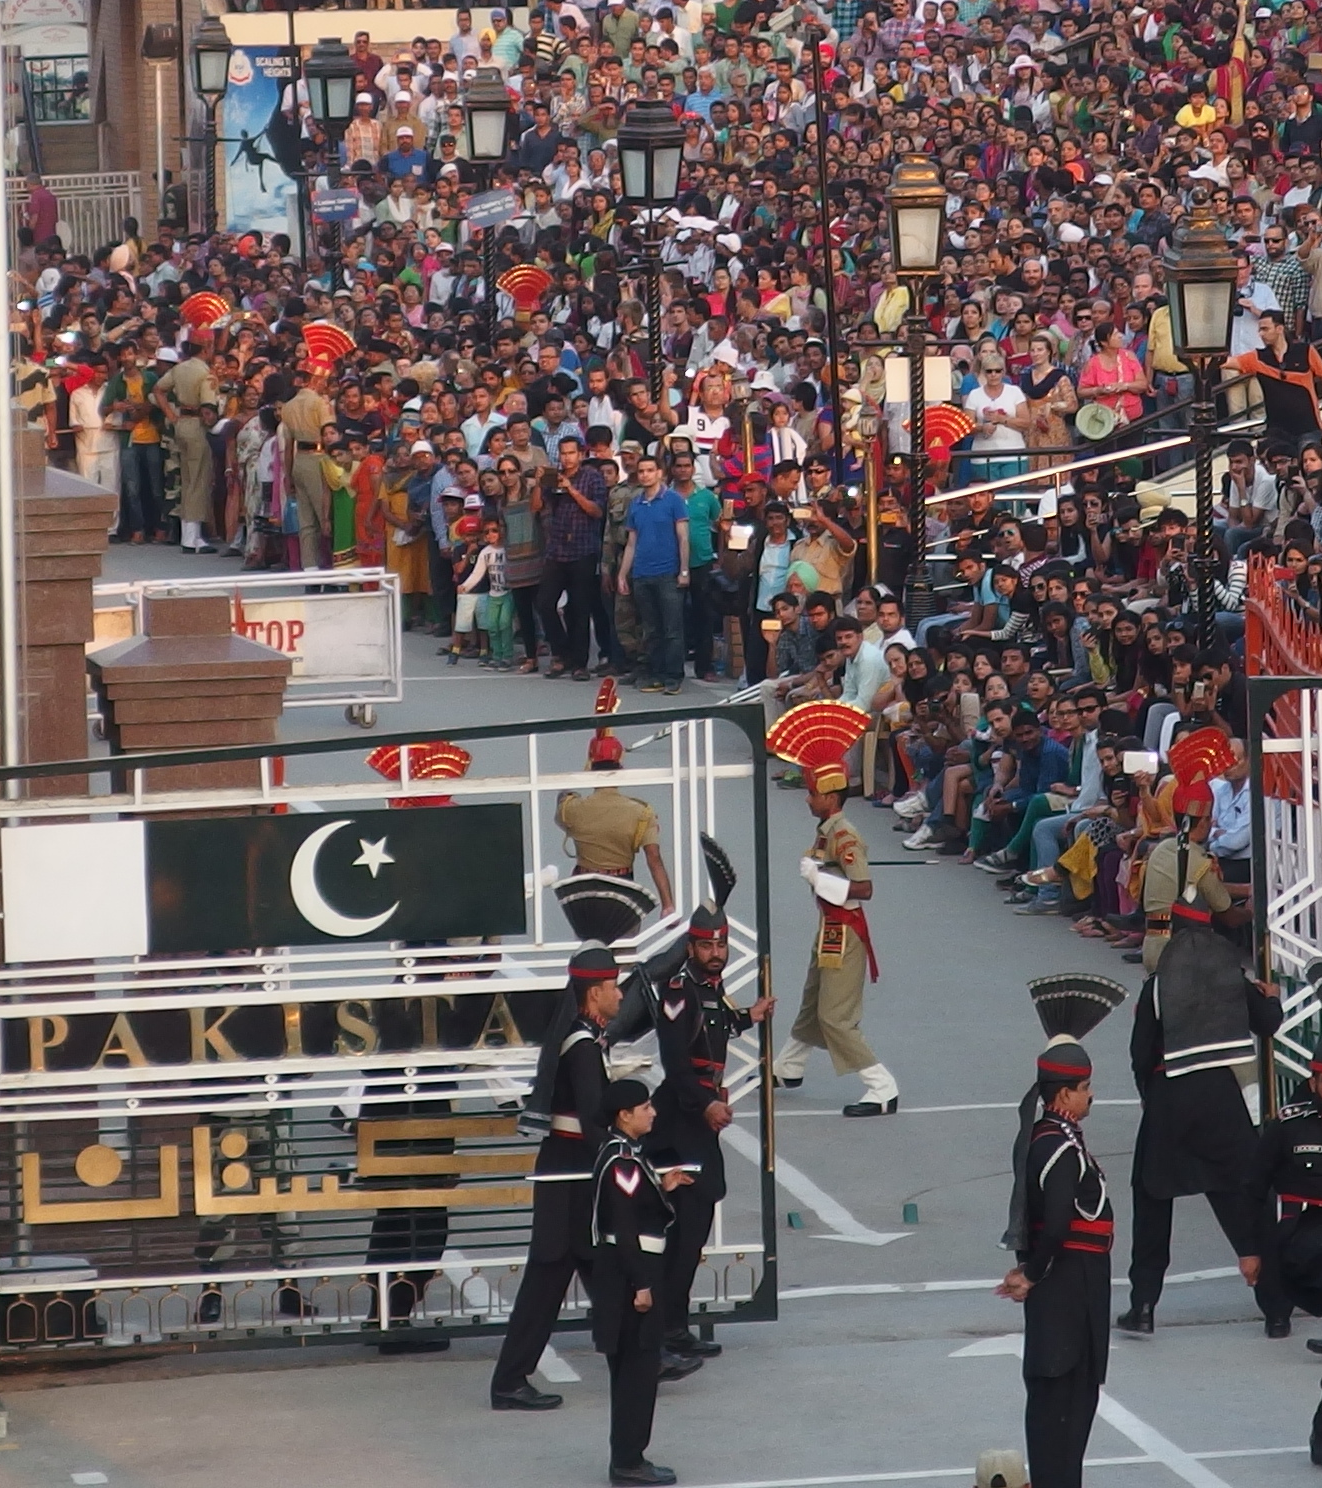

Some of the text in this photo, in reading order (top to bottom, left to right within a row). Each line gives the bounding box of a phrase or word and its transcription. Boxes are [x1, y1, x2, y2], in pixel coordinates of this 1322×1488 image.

[697, 418, 706, 431] 9
[231, 619, 304, 652] TOP
[28, 993, 525, 1073] PAKISTA
